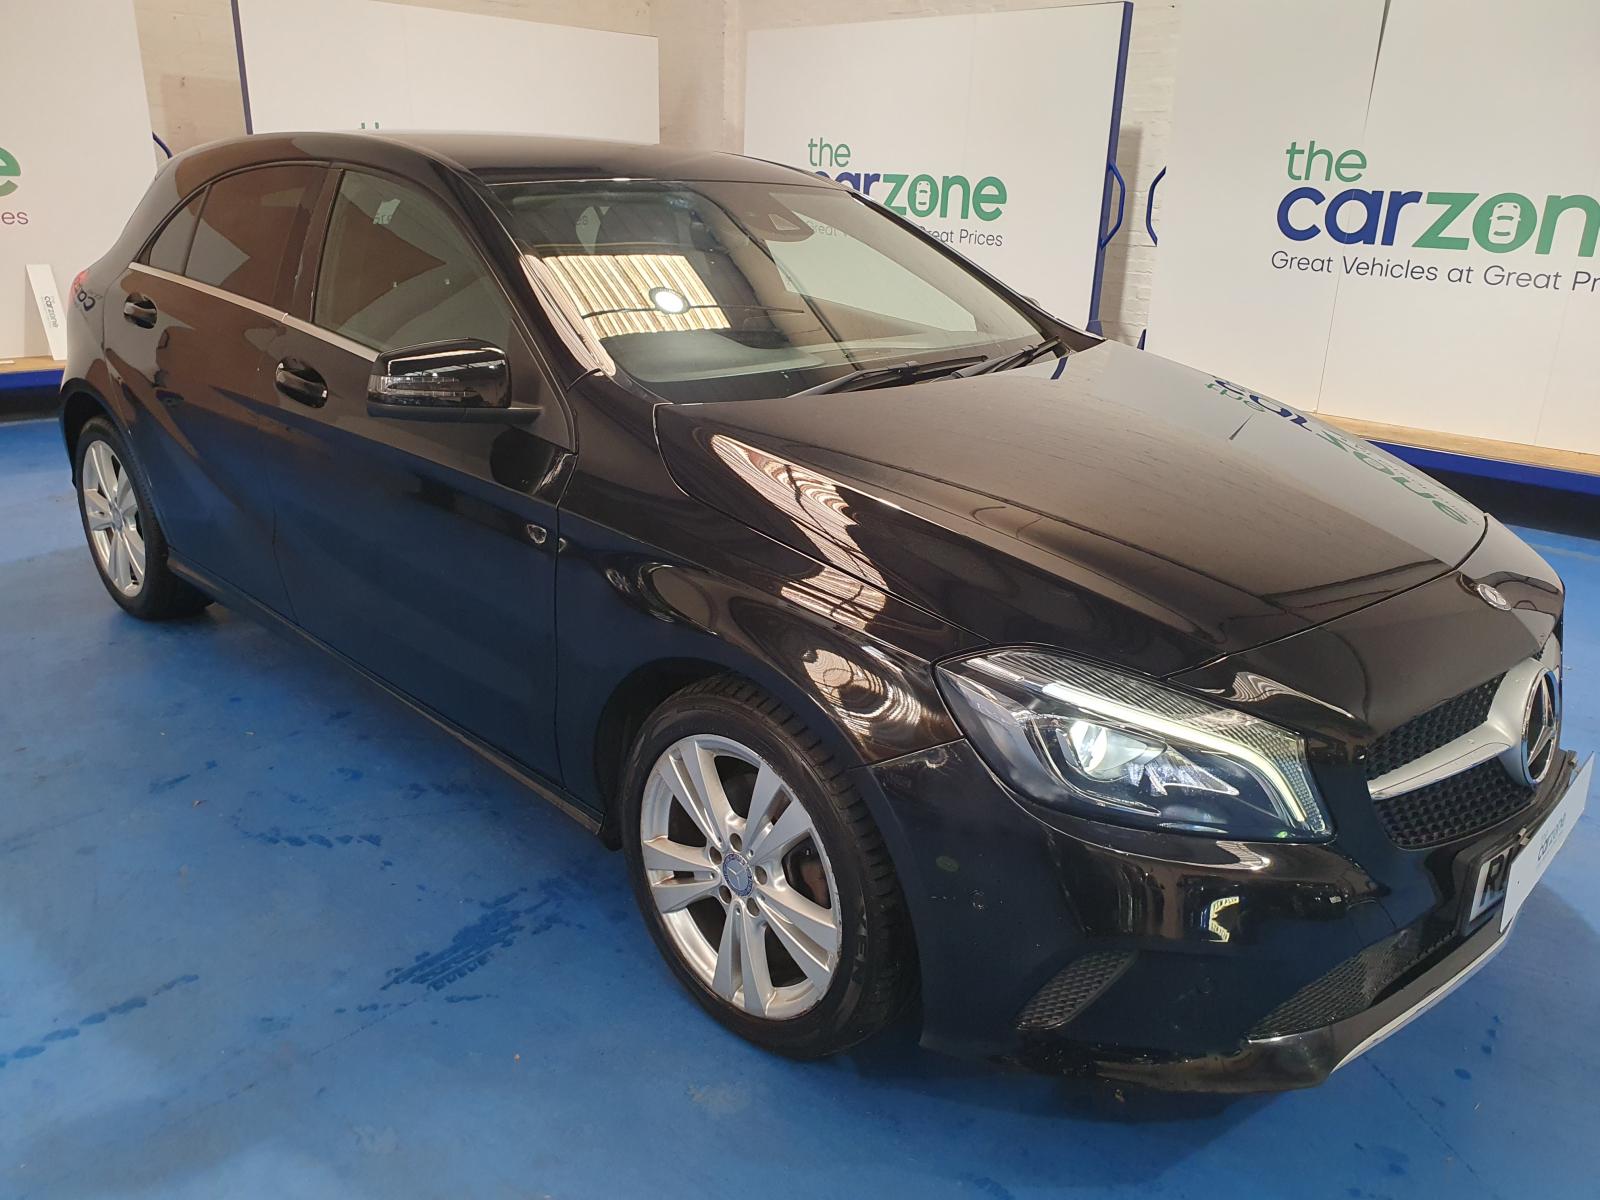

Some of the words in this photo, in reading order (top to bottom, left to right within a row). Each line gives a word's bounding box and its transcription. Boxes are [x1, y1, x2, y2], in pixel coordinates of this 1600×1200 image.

[808, 137, 851, 168] the
[1286, 140, 1368, 183] the
[814, 171, 1008, 222] rzone
[959, 228, 1003, 247] Prices
[1271, 250, 1334, 274] Great
[1343, 255, 1439, 281] Vehicles
[1447, 266, 1474, 284] at
[1483, 265, 1562, 290] Great
